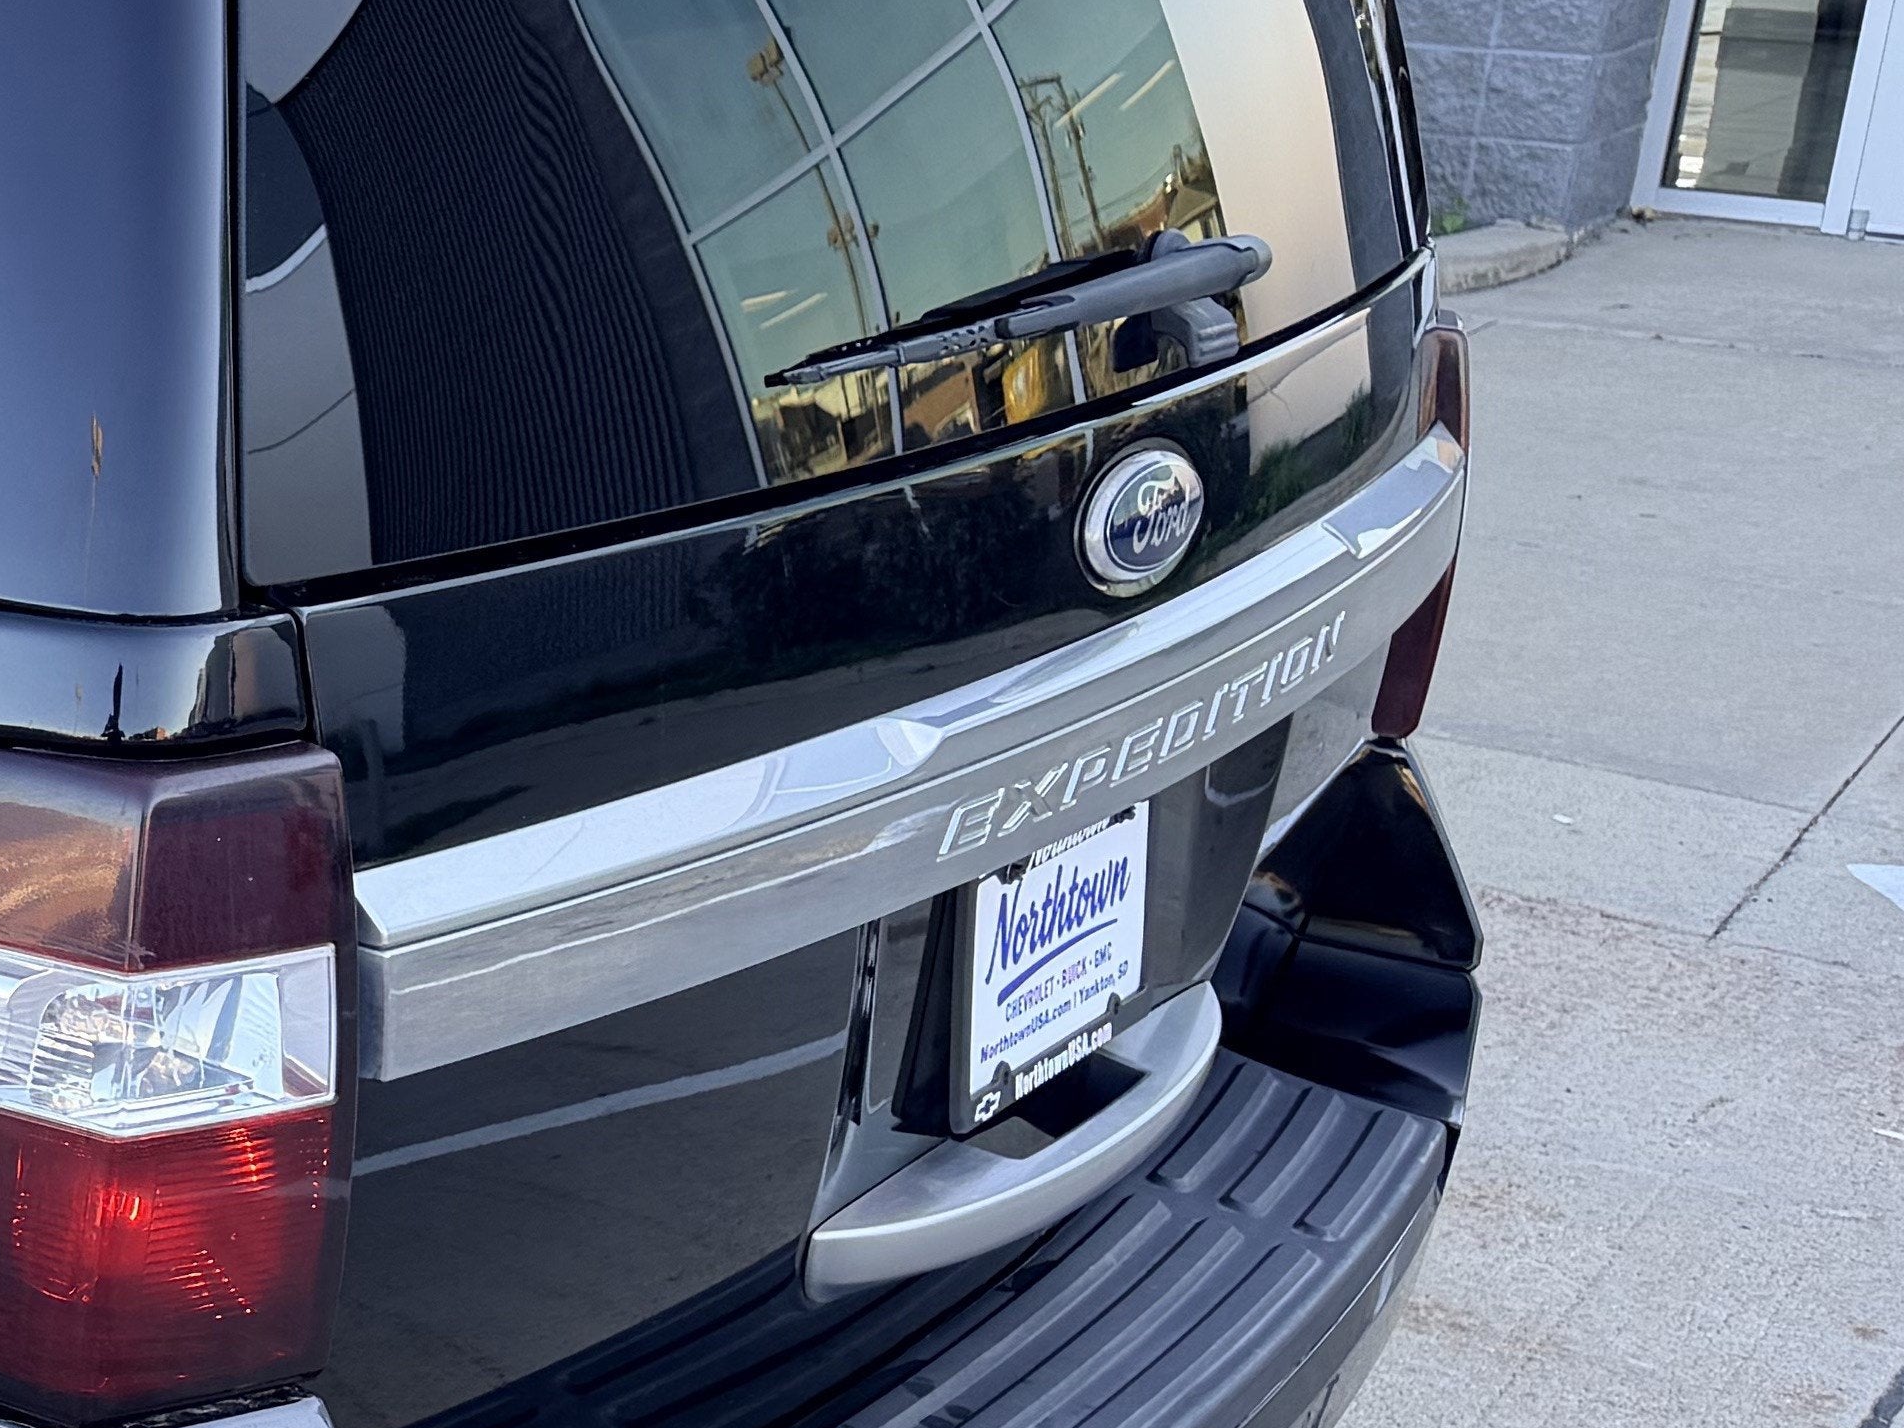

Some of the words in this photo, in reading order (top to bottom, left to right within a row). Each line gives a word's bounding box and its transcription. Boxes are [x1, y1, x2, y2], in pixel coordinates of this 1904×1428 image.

[1131, 468, 1190, 555] Ford
[936, 610, 1347, 862] EXPEDITION
[985, 856, 1132, 985] Northtown
[980, 999, 1072, 1064] NorthtownUSA.com
[1005, 976, 1054, 1022] CHEVROLET
[1015, 1022, 1113, 1101] NorthtownUSA.com
